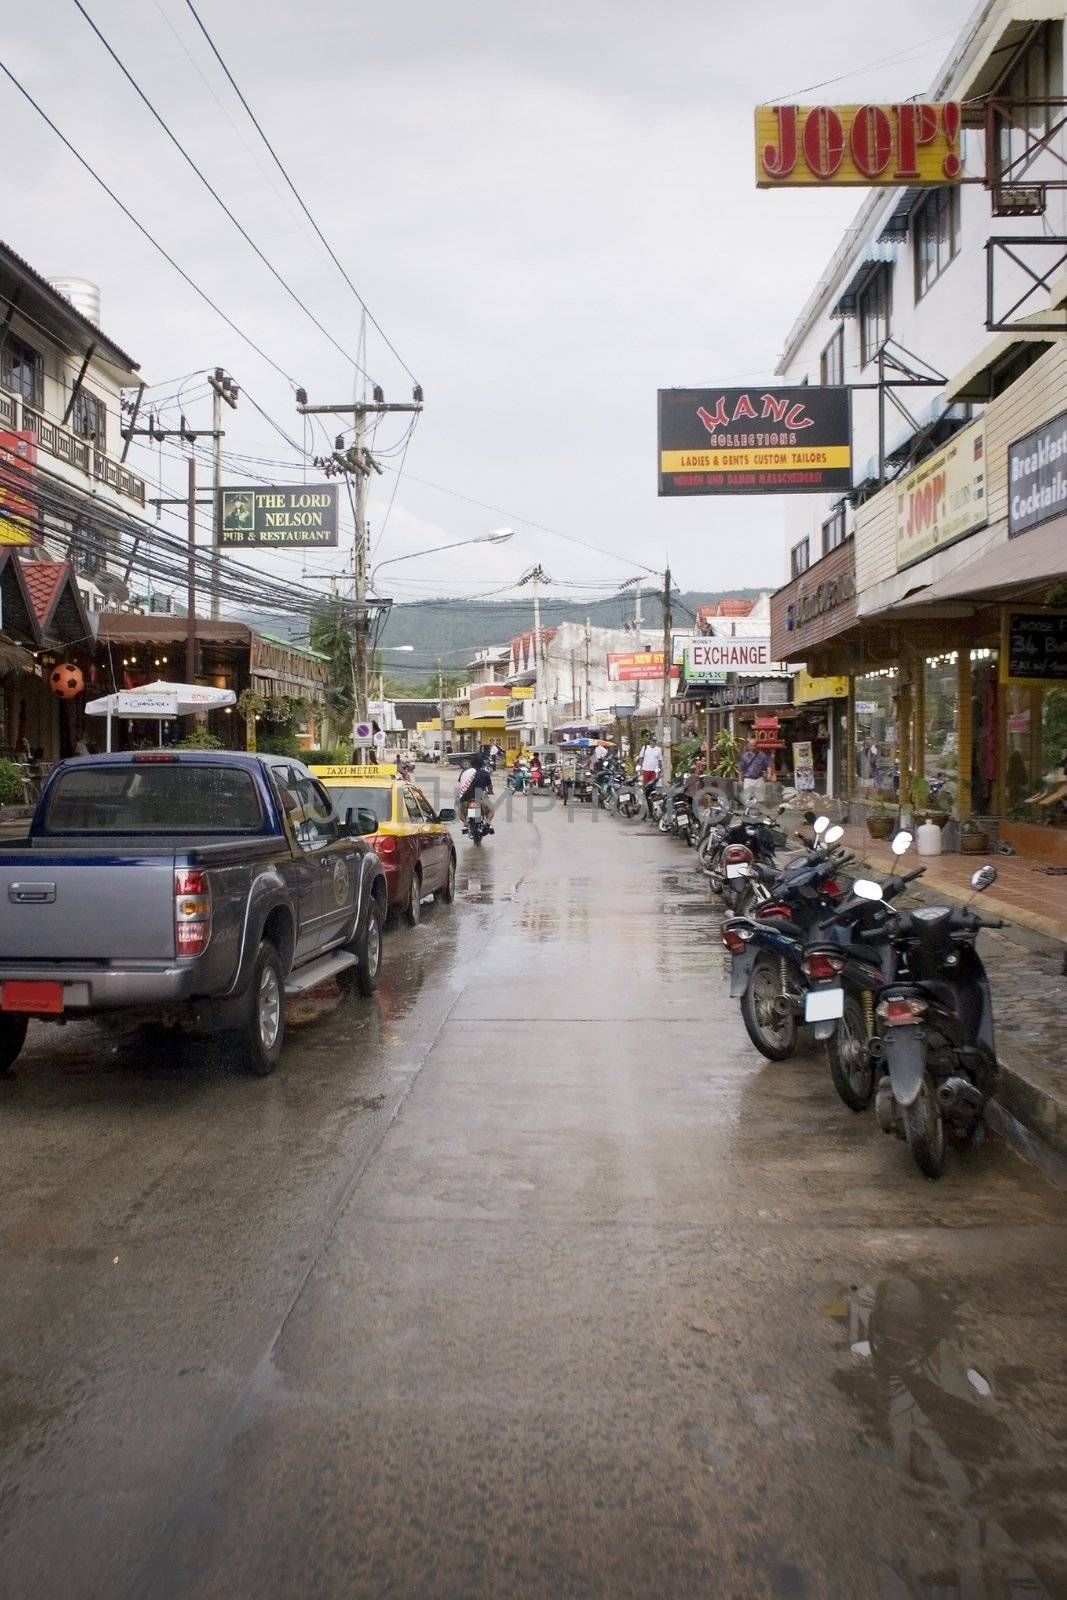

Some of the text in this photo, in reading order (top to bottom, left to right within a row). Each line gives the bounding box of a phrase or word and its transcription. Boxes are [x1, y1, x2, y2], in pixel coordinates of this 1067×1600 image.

[762, 102, 961, 178] JOOP!
[710, 432, 797, 447] COLLECTIONS
[681, 452, 827, 467] LADIES & GENTS CUSTOM TAILORS
[256, 494, 332, 508] THE LORD
[1012, 471, 1067, 521] Cocktails
[265, 512, 322, 527] NELSON
[223, 531, 331, 541] PUB & RESTAURANT
[694, 646, 767, 665] EXCHANGE
[326, 766, 380, 776] TAXI-METER
